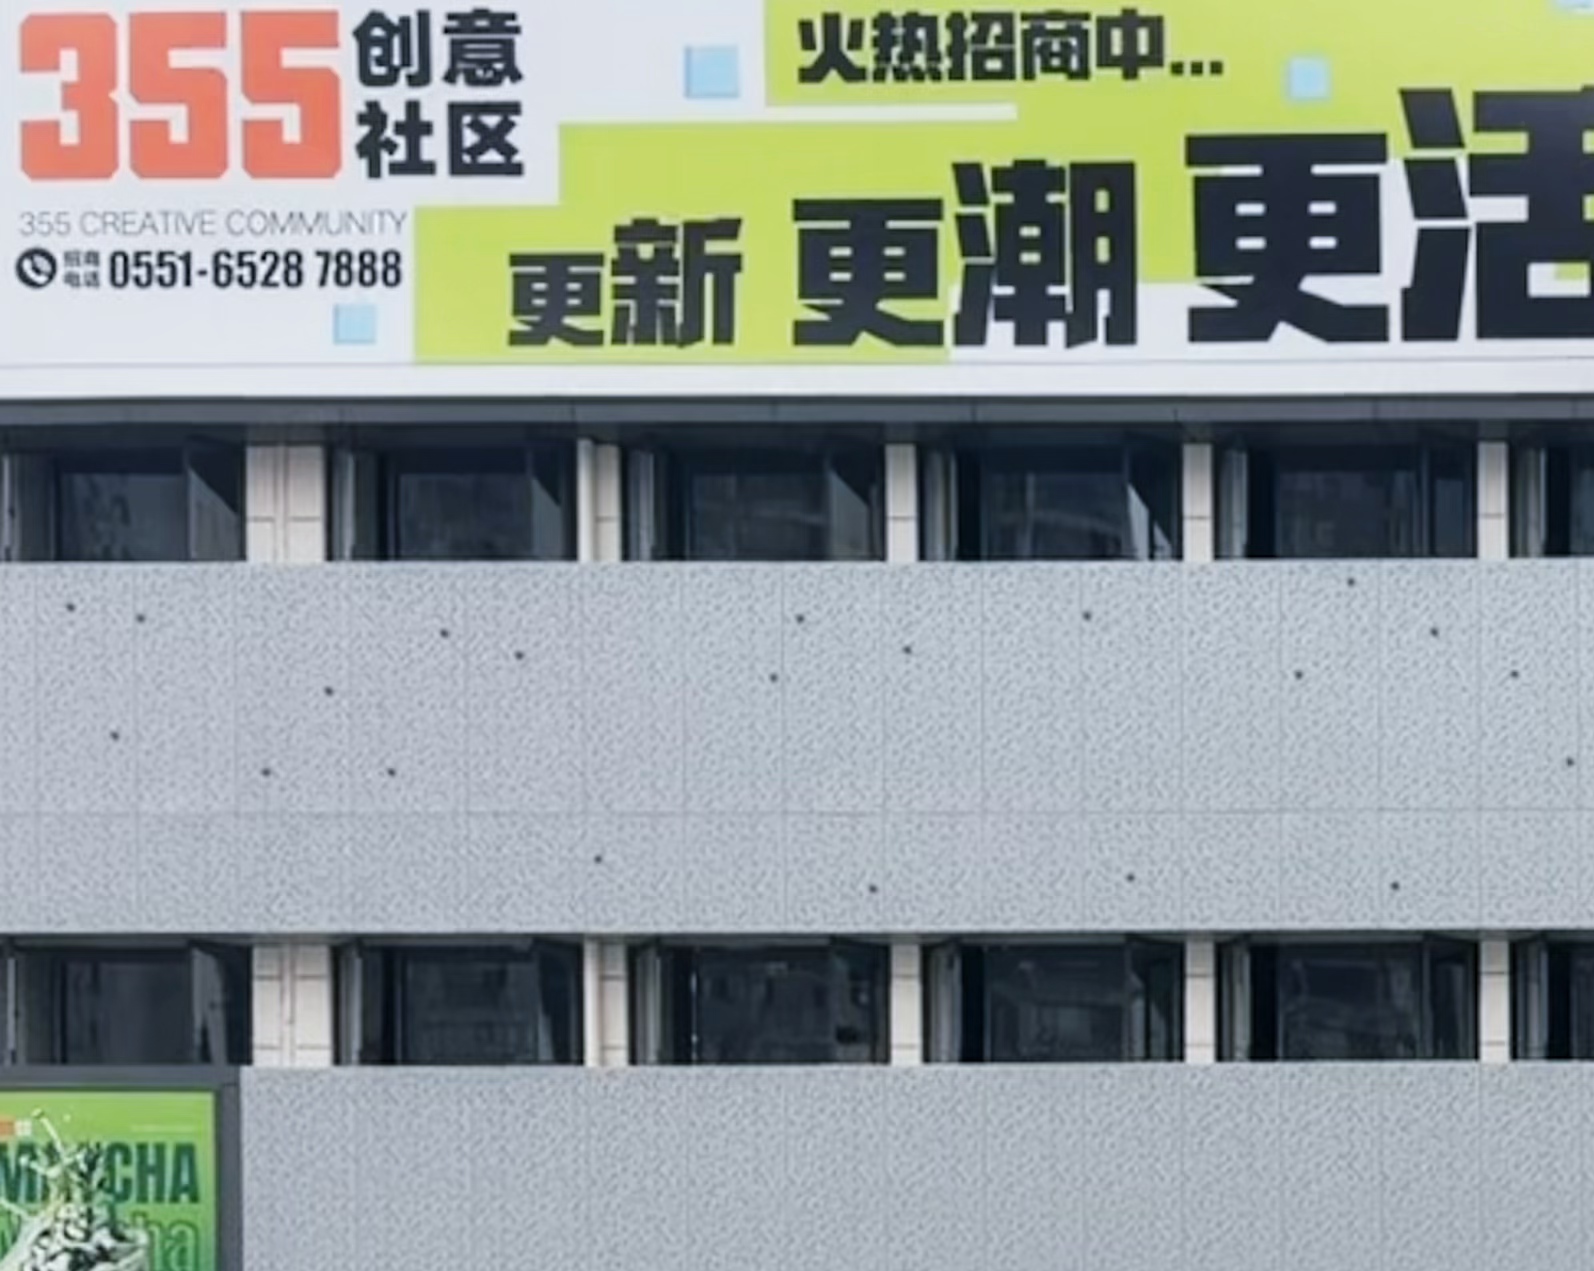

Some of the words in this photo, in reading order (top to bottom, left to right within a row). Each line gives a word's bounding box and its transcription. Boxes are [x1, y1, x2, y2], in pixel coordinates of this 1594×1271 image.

[353, 10, 523, 88] 创意
[20, 11, 342, 181] 355
[355, 100, 525, 179] 社区
[19, 212, 71, 237] 355
[80, 211, 216, 236] CREATIVE
[234, 210, 408, 236] COMMUNITY
[792, 158, 1138, 348] 更潮
[64, 271, 101, 288] 电话
[109, 250, 304, 289] 0551-6528
[315, 250, 401, 288] 7888
[508, 217, 742, 348] 更新
